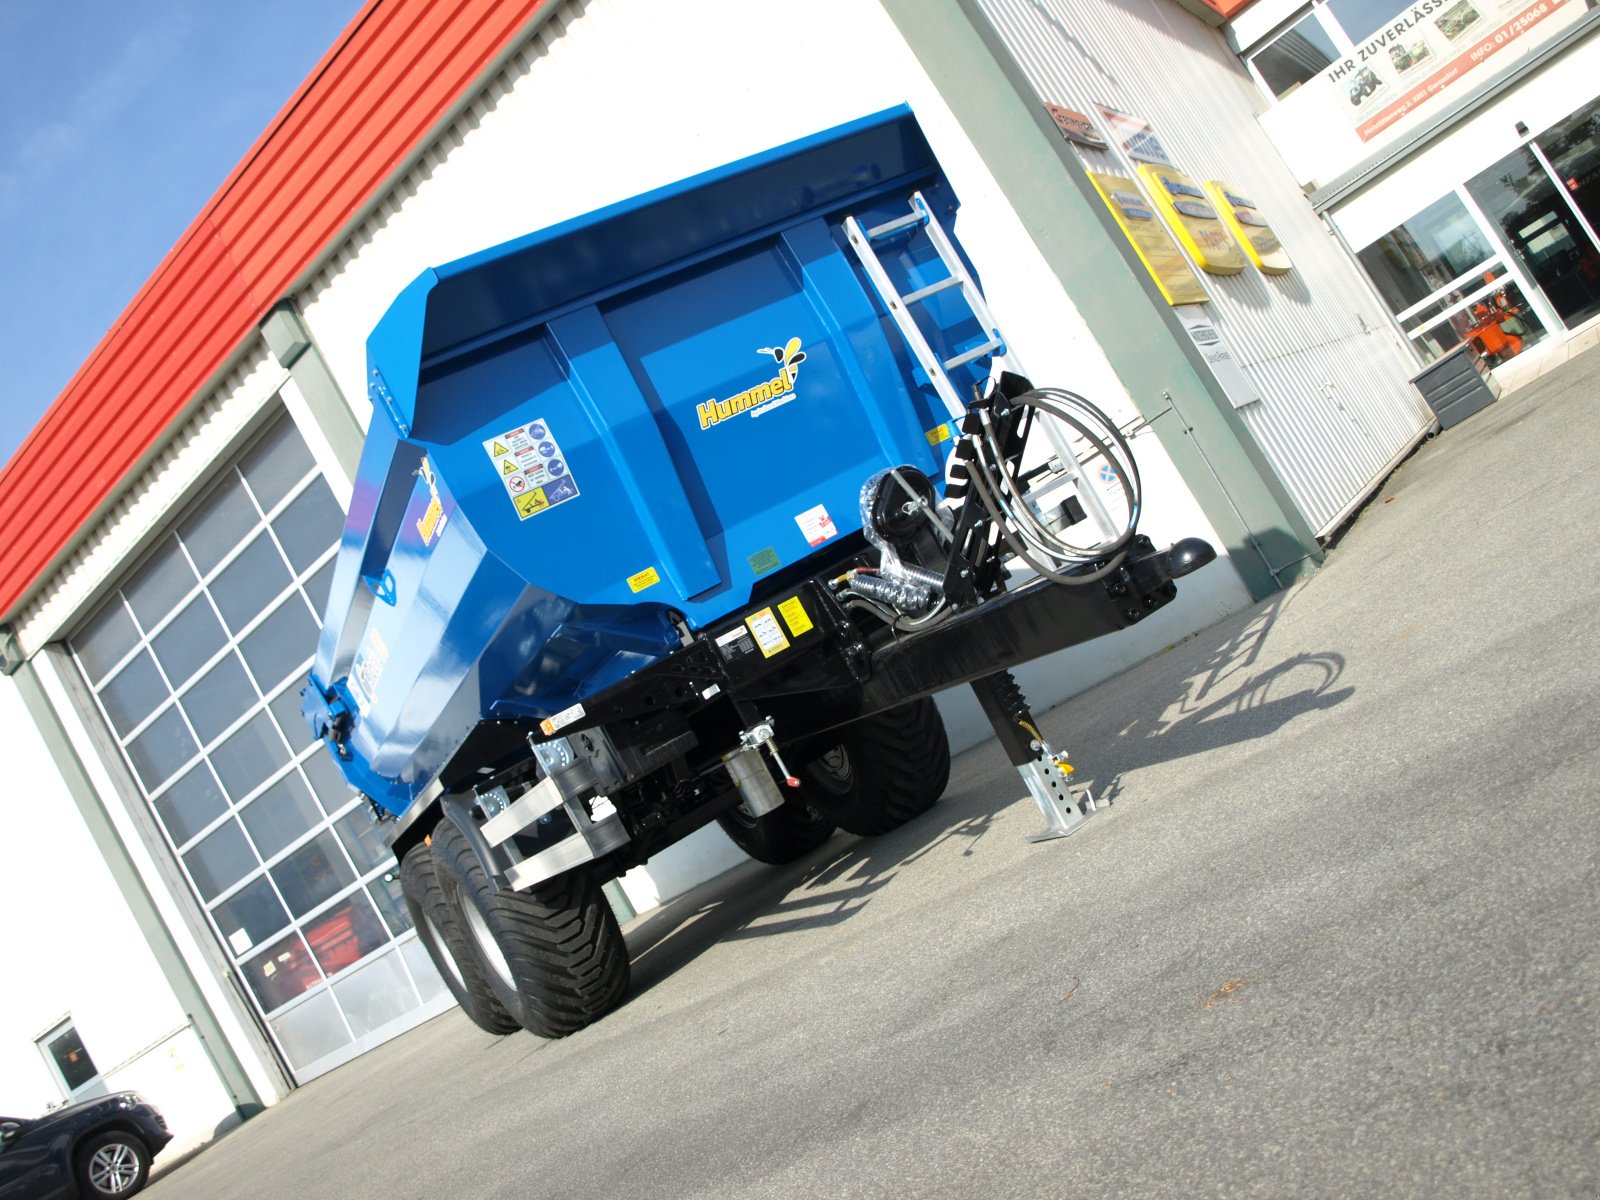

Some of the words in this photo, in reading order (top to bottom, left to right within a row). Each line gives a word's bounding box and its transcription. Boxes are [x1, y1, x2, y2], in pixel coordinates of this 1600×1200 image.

[1328, 59, 1356, 83] IHR
[1357, 0, 1448, 62] ZUVERLÄSS
[1469, 41, 1496, 62] INFO:
[1494, 3, 1549, 46] 01/25068
[697, 367, 793, 429] Hummel
